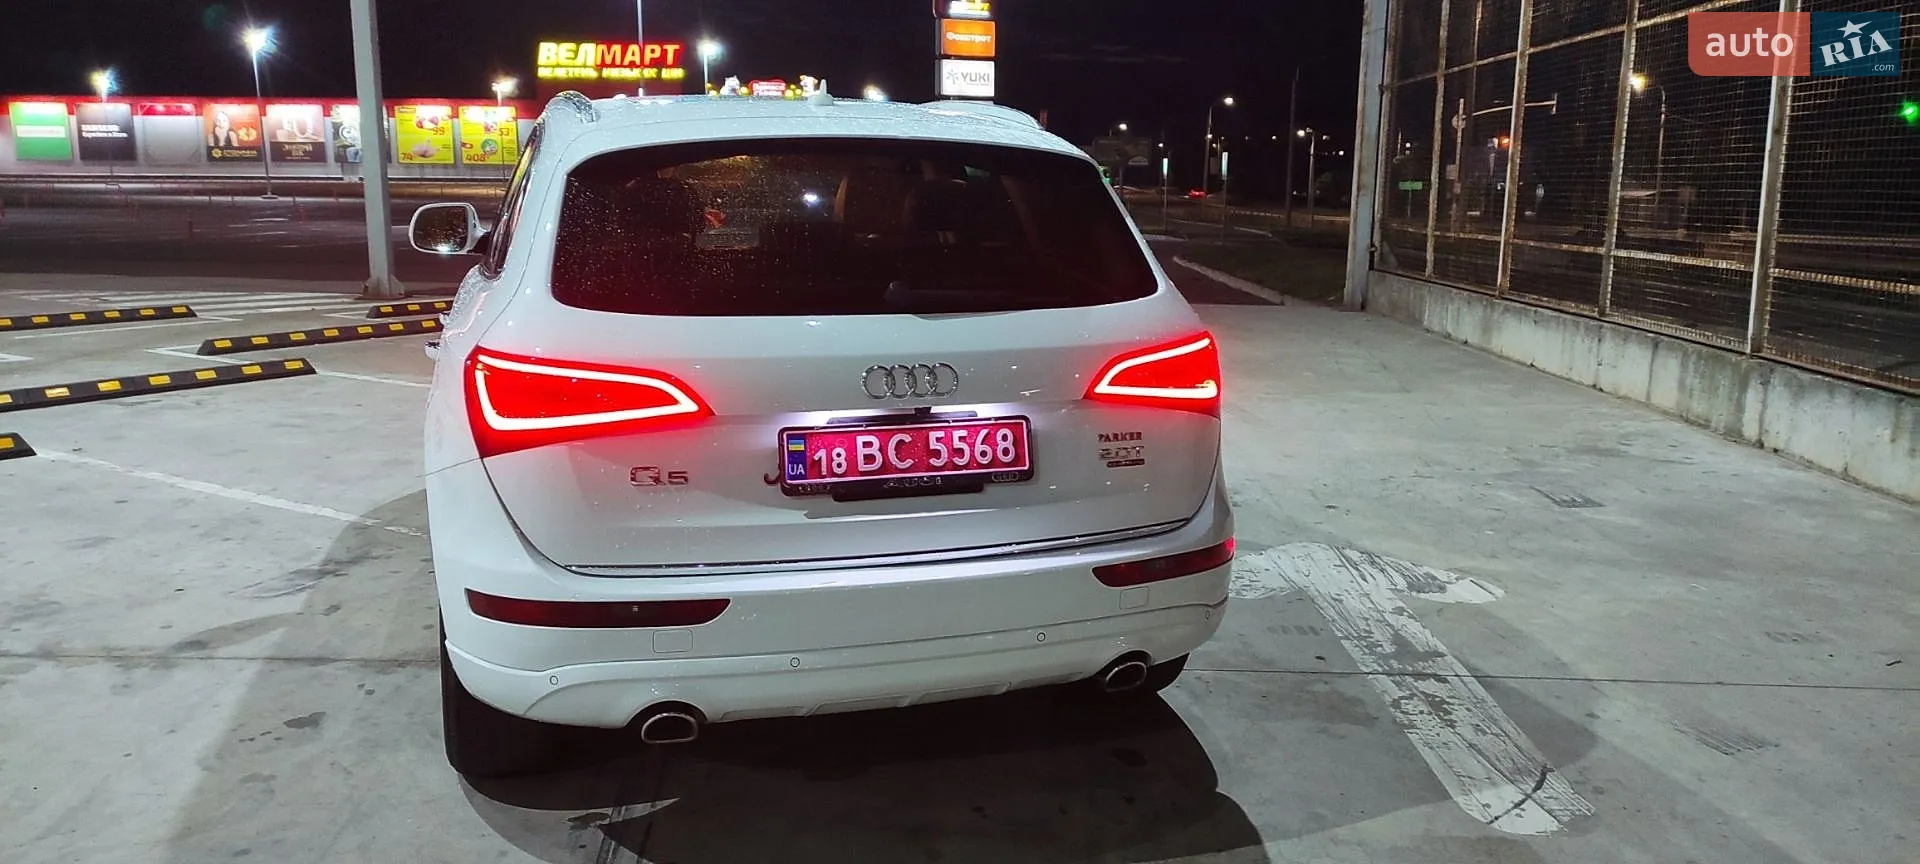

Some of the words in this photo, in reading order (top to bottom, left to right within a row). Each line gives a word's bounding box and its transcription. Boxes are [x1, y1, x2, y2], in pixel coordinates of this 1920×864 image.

[537, 42, 681, 66] ВЕЛМАРТ
[960, 72, 990, 83] YUKI
[1098, 432, 1142, 442] PARKER
[813, 448, 847, 475] 18
[856, 433, 914, 472] BC
[928, 427, 1015, 468] 5568
[629, 466, 689, 487] Q5
[788, 463, 805, 476] UA
